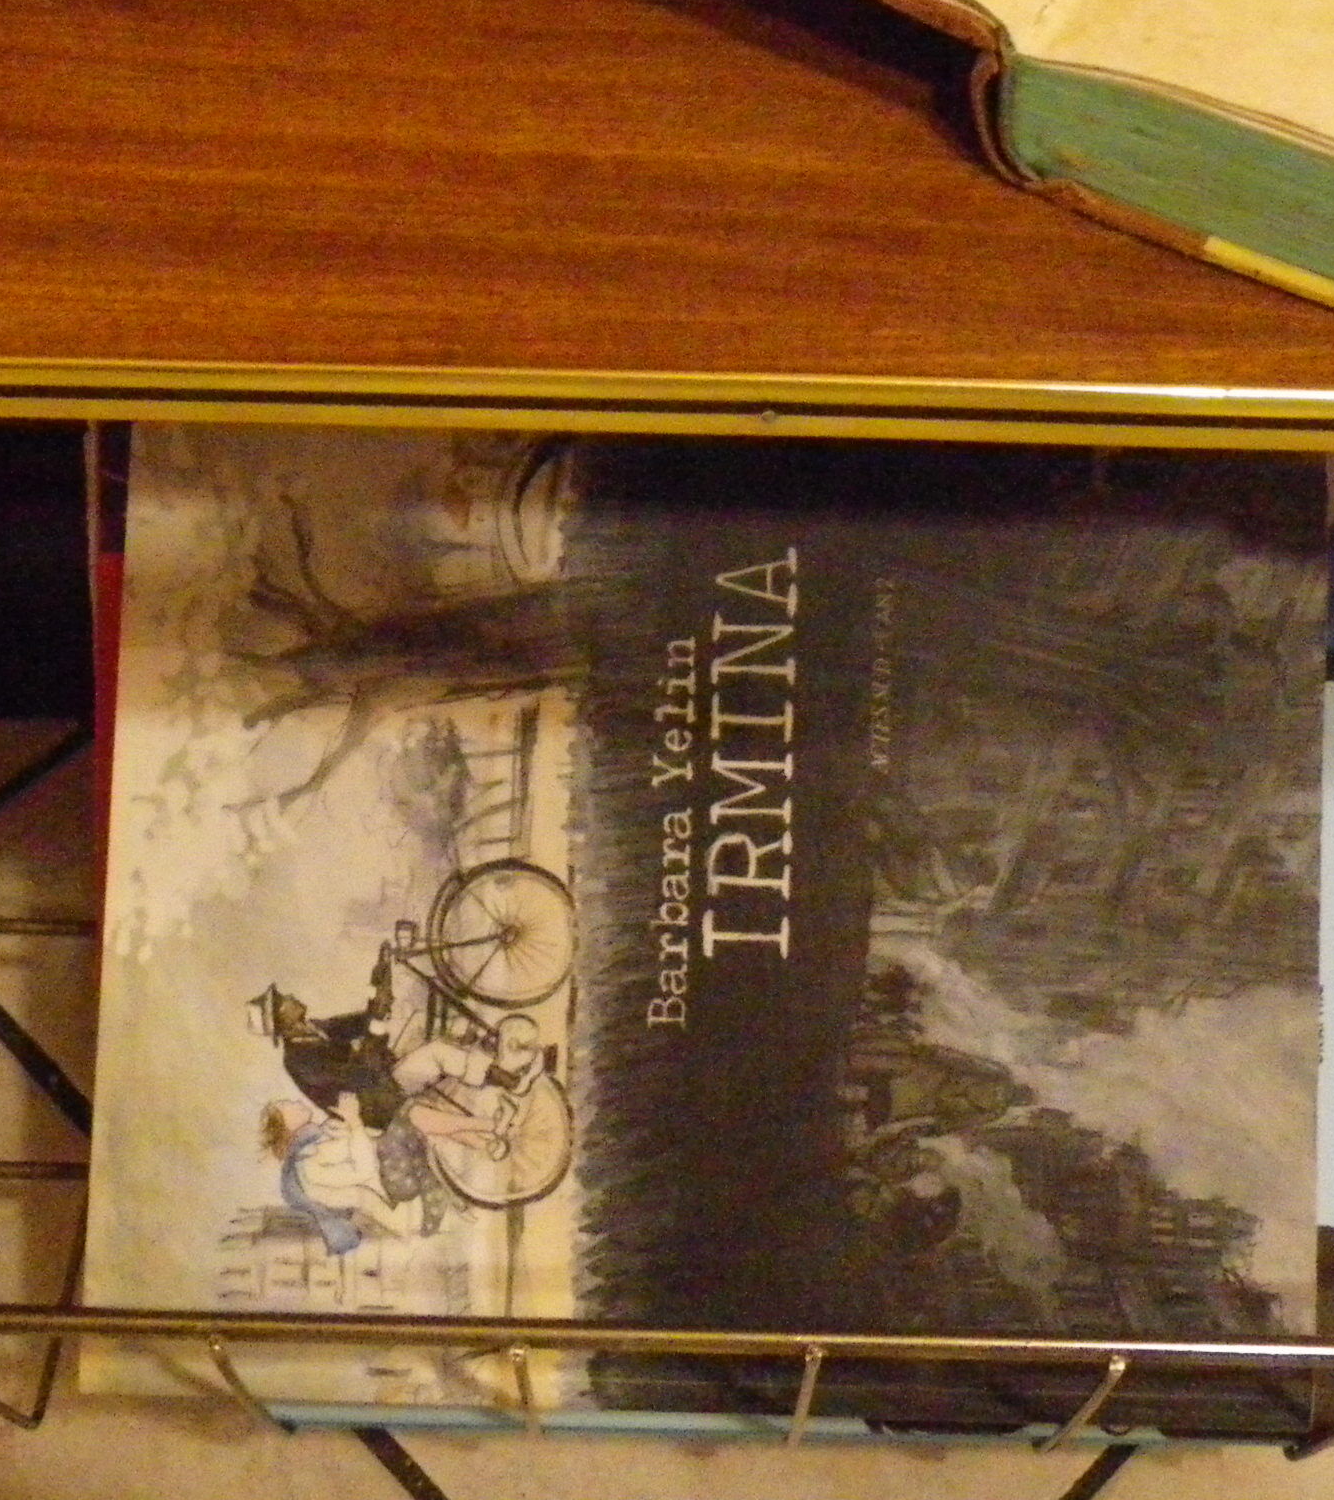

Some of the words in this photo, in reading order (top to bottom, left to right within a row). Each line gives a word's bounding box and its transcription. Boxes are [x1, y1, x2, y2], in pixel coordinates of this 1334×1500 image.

[651, 635, 696, 789] Yelin
[702, 546, 798, 959] IRMINA
[646, 807, 693, 1030] Barbara
